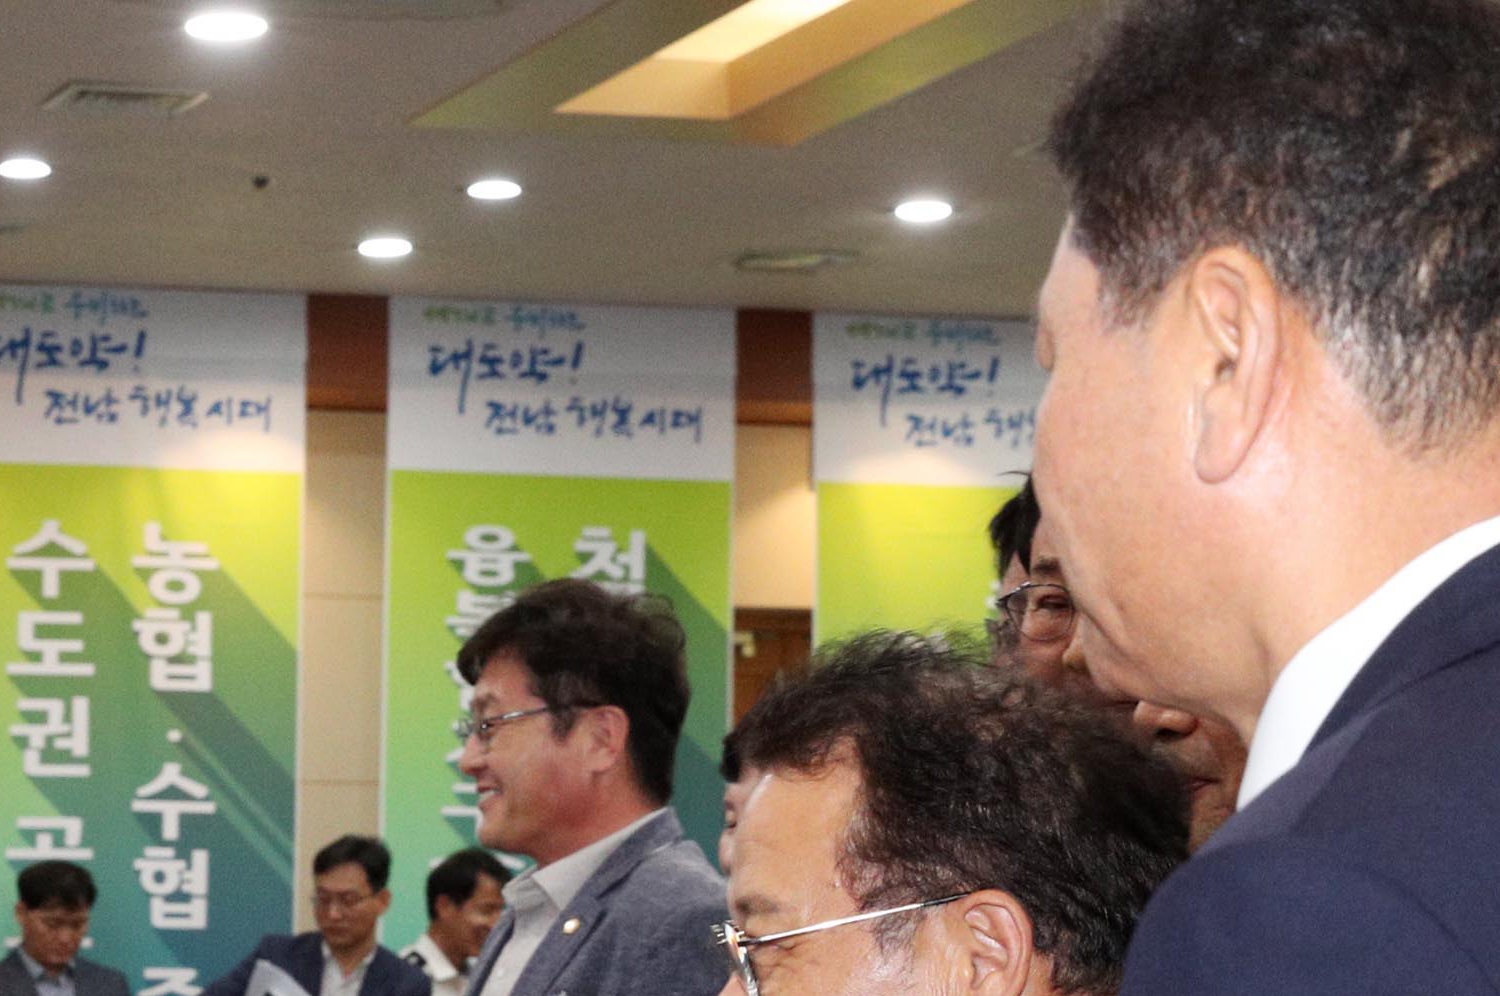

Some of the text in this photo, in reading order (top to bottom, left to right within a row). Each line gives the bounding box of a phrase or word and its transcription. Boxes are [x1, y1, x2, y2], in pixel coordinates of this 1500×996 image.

[428, 338, 586, 415] 대도약!
[851, 354, 1000, 428] 대도약!
[44, 388, 120, 425] 전남
[485, 400, 557, 436] 전남
[905, 412, 975, 448] 전남
[5, 519, 98, 779] 수도권
